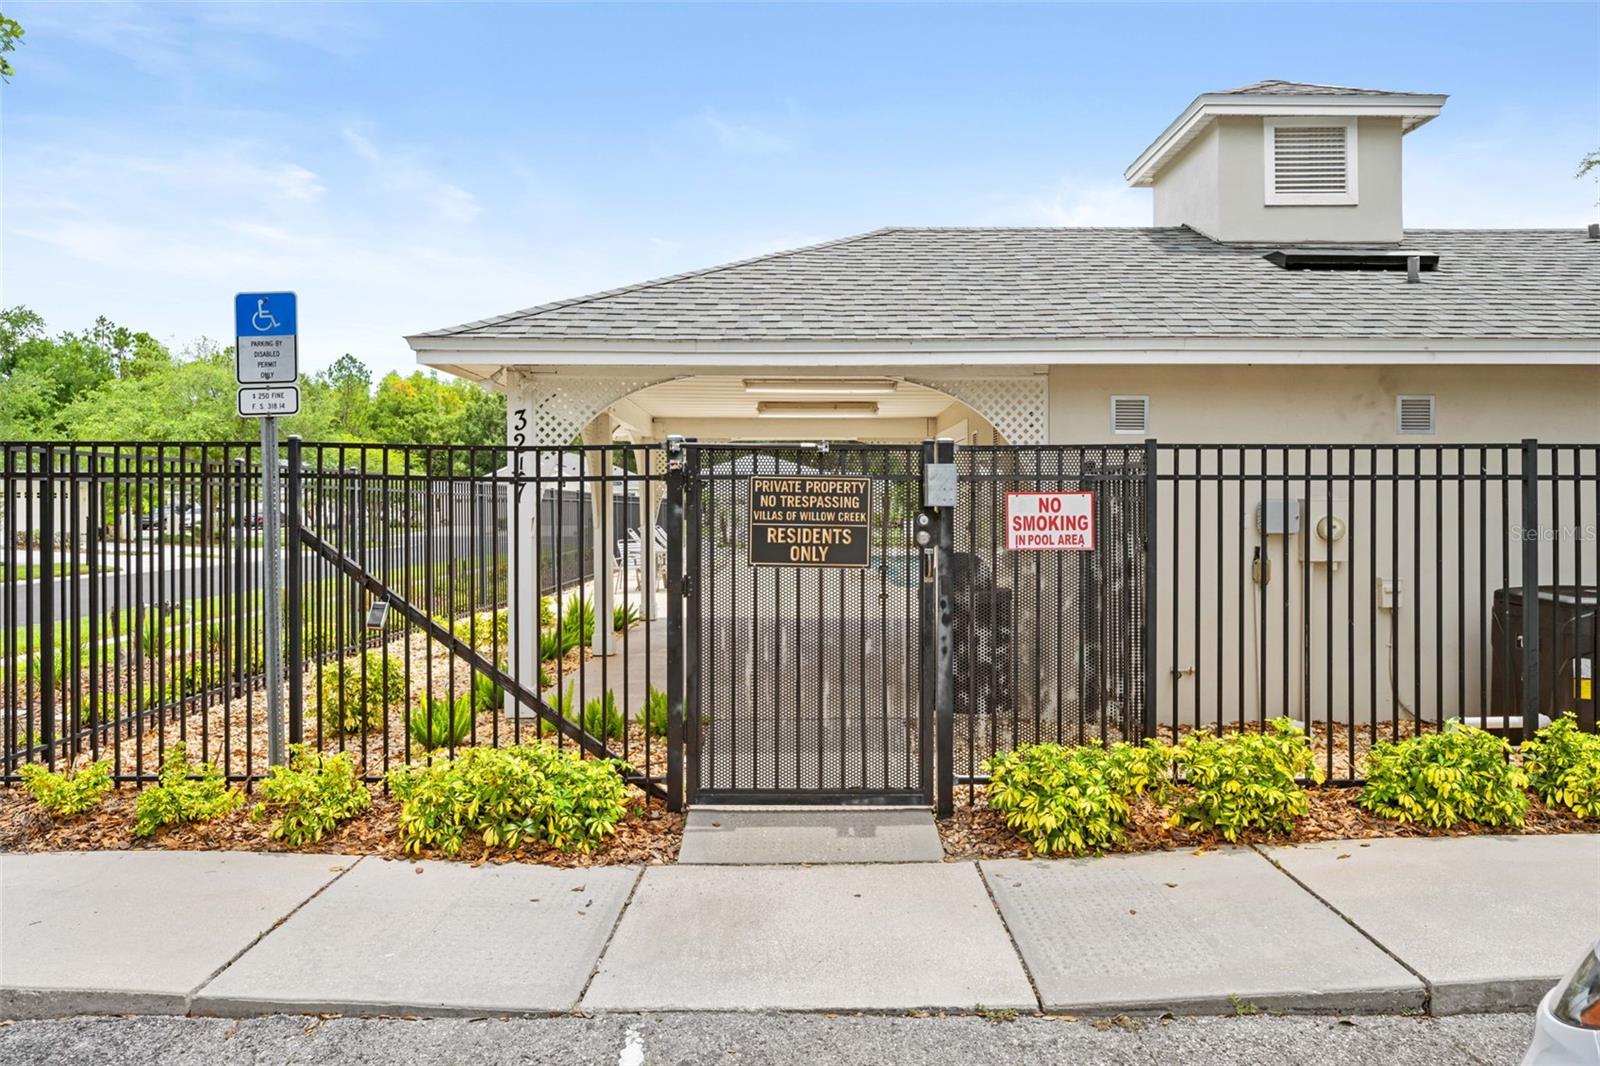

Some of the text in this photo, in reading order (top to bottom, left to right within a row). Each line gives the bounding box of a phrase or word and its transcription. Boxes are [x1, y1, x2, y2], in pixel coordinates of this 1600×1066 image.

[754, 480, 866, 494] PRIVATE PROPERTY
[760, 495, 860, 508] NO TRESPASSING
[1039, 497, 1061, 513] NO
[753, 510, 867, 522] VILLAS OF WILLOW CREEK
[1013, 515, 1089, 531] SMOKING
[767, 527, 852, 545] RESIDENTS
[1015, 534, 1085, 546] IN POOL AREA
[790, 546, 829, 562] ONLY
